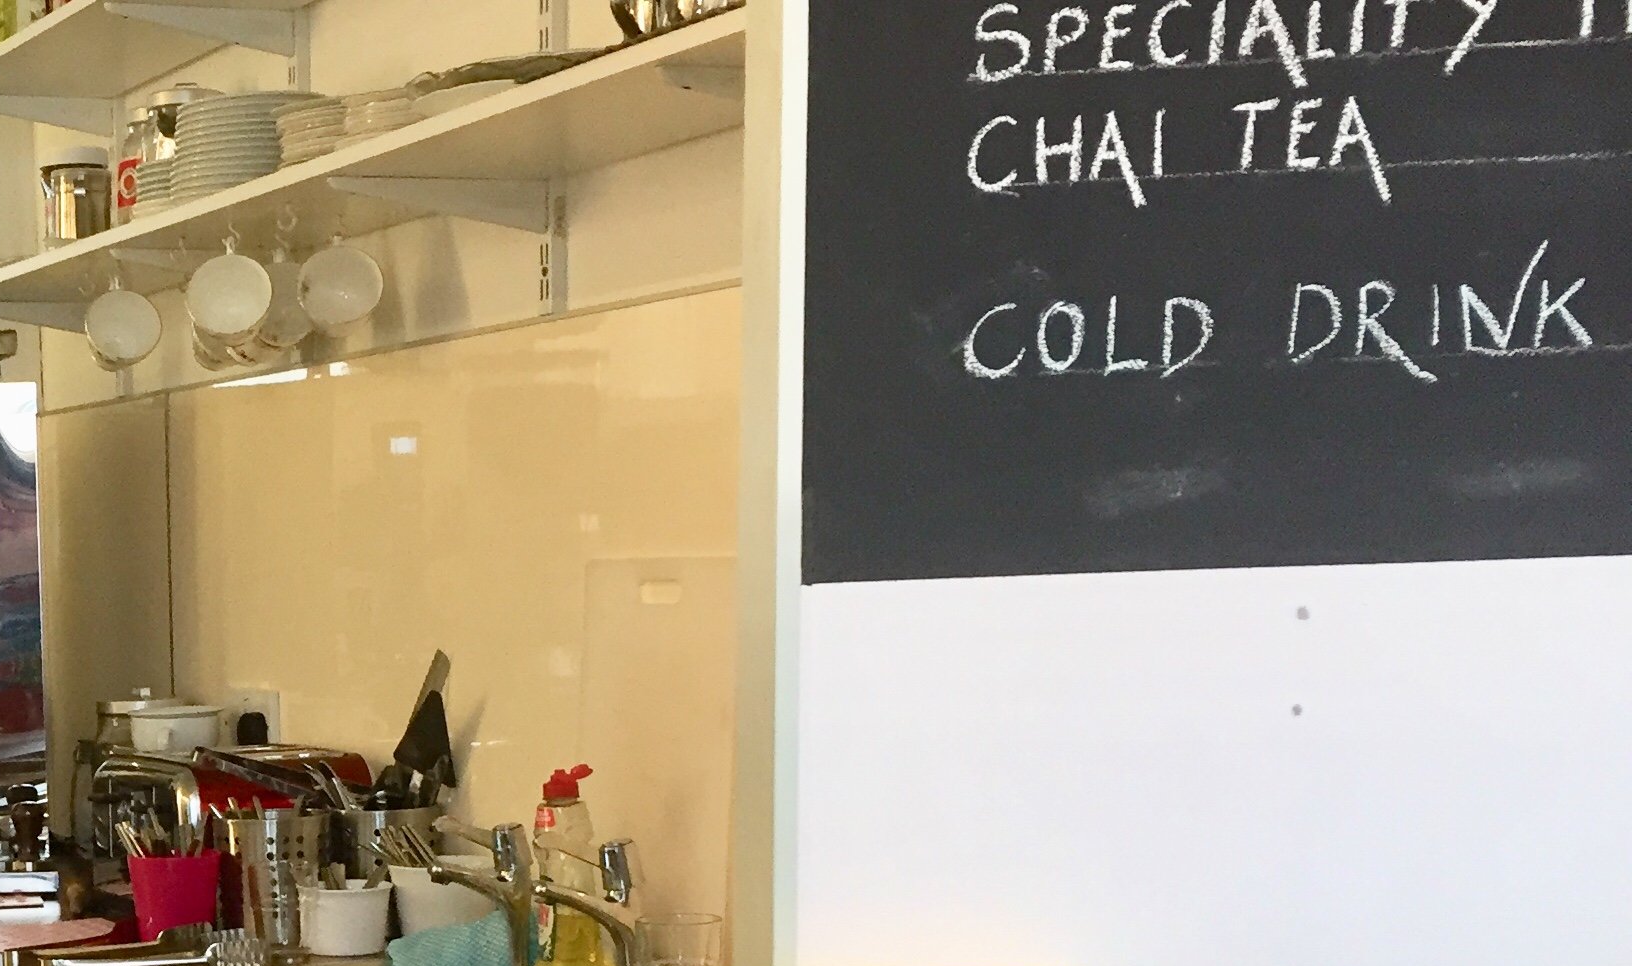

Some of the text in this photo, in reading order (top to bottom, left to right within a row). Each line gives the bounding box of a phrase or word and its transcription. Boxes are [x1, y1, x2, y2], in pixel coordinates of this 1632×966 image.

[974, 0, 1497, 88] SPECIALITY
[968, 96, 1391, 207] CHAI TEA
[963, 240, 1594, 384] COLD DRINK
